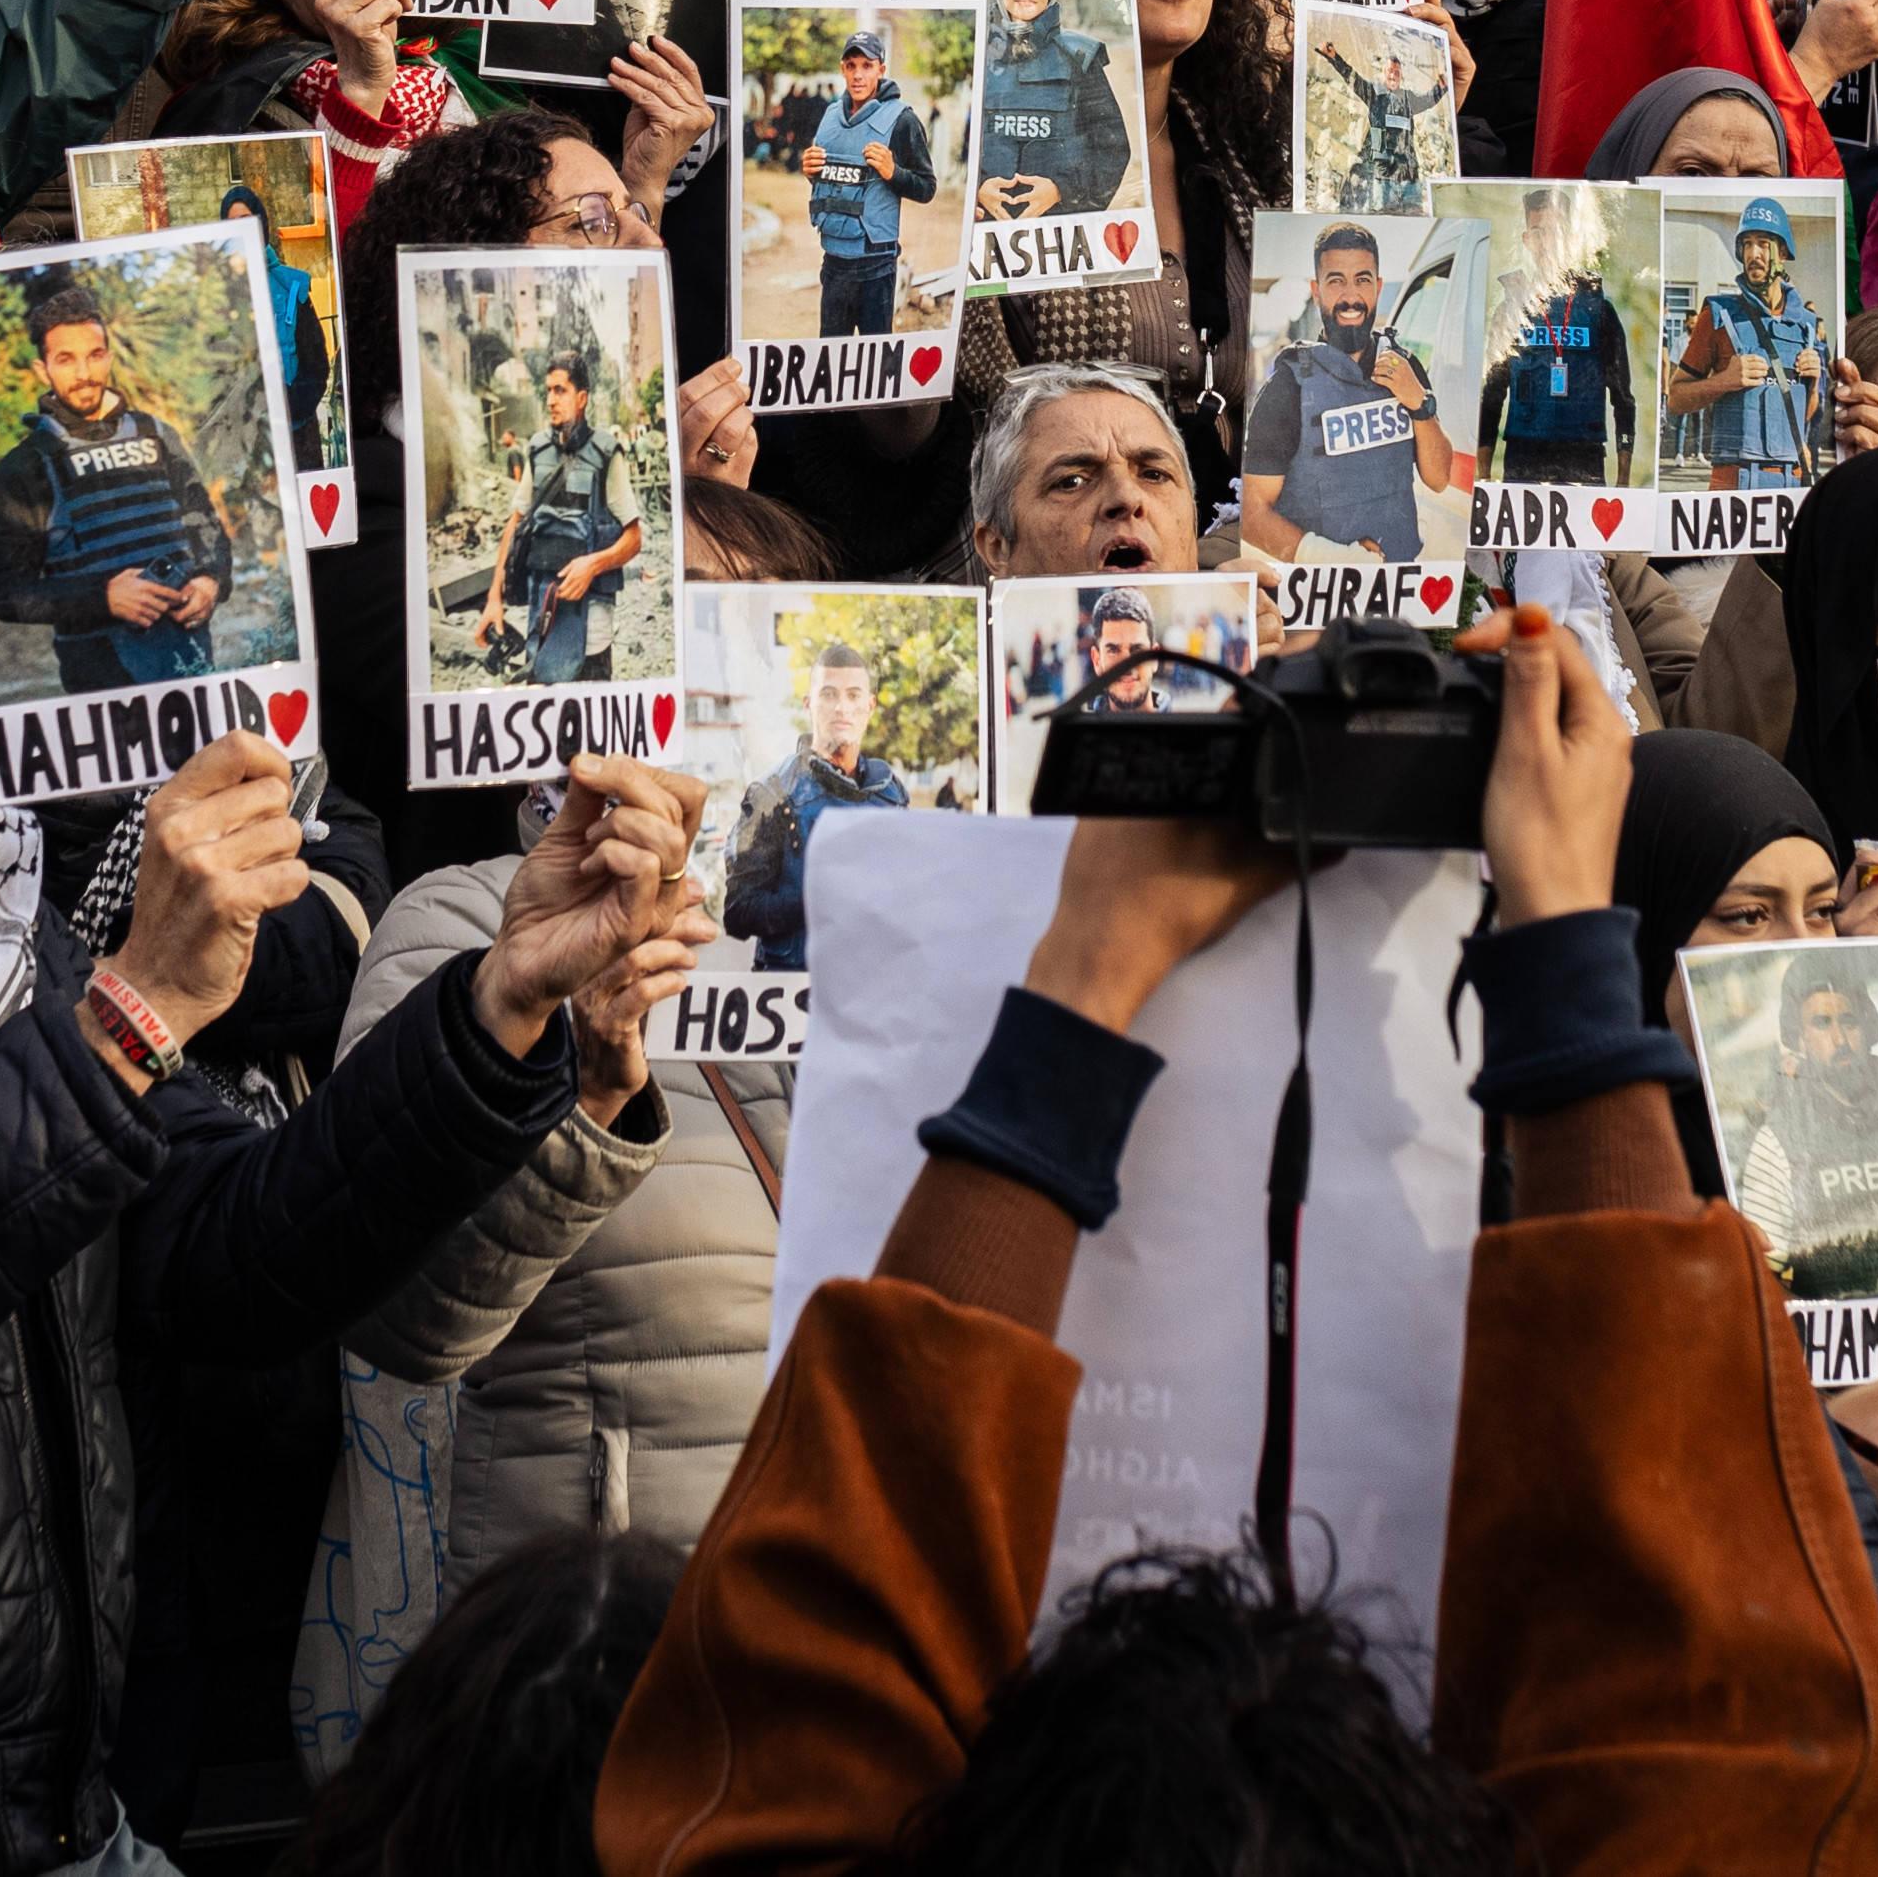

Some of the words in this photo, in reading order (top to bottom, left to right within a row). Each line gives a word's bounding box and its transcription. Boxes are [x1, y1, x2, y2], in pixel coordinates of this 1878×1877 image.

[994, 115, 1050, 138] PRESS
[822, 165, 860, 183] PRESS
[1523, 327, 1589, 347] PRESS
[749, 340, 904, 407] IBRAHIM
[1326, 403, 1410, 451] PRESS
[70, 439, 158, 475] PRESS
[1470, 489, 1578, 549] BADR
[1671, 494, 1794, 551] NADER
[425, 693, 649, 778] HASSOUNA
